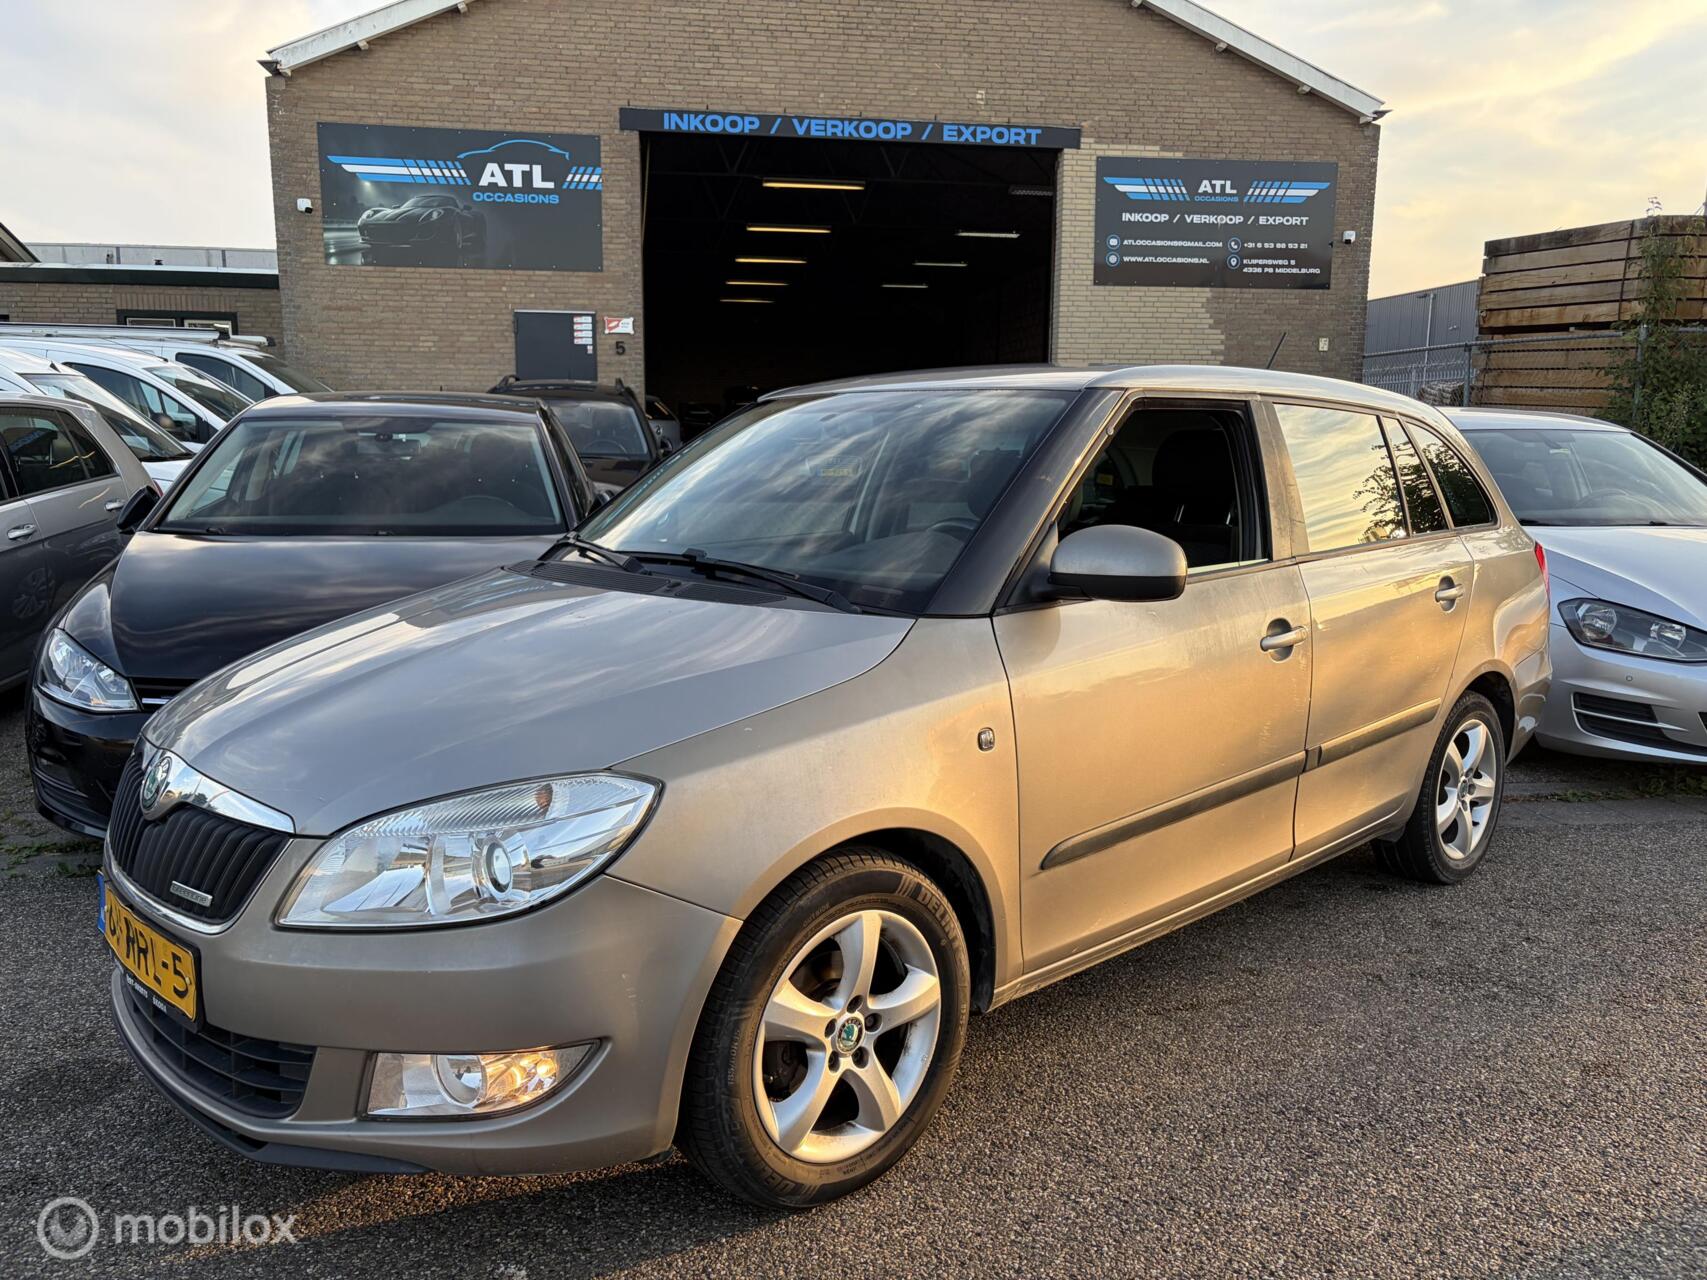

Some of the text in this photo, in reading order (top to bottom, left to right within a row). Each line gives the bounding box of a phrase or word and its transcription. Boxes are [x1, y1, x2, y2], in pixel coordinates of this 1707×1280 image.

[663, 112, 1042, 145] INKOOP / VERKOOP / EXPORT
[478, 162, 555, 189] ATL
[1198, 179, 1237, 194] ATL
[472, 191, 560, 204] OCCASIONS
[1121, 212, 1309, 226] INKOOP / VERKOOP / EXPORT
[1123, 256, 1210, 264] WWW.ATLOCCASIONS.NL
[615, 340, 626, 356] 5
